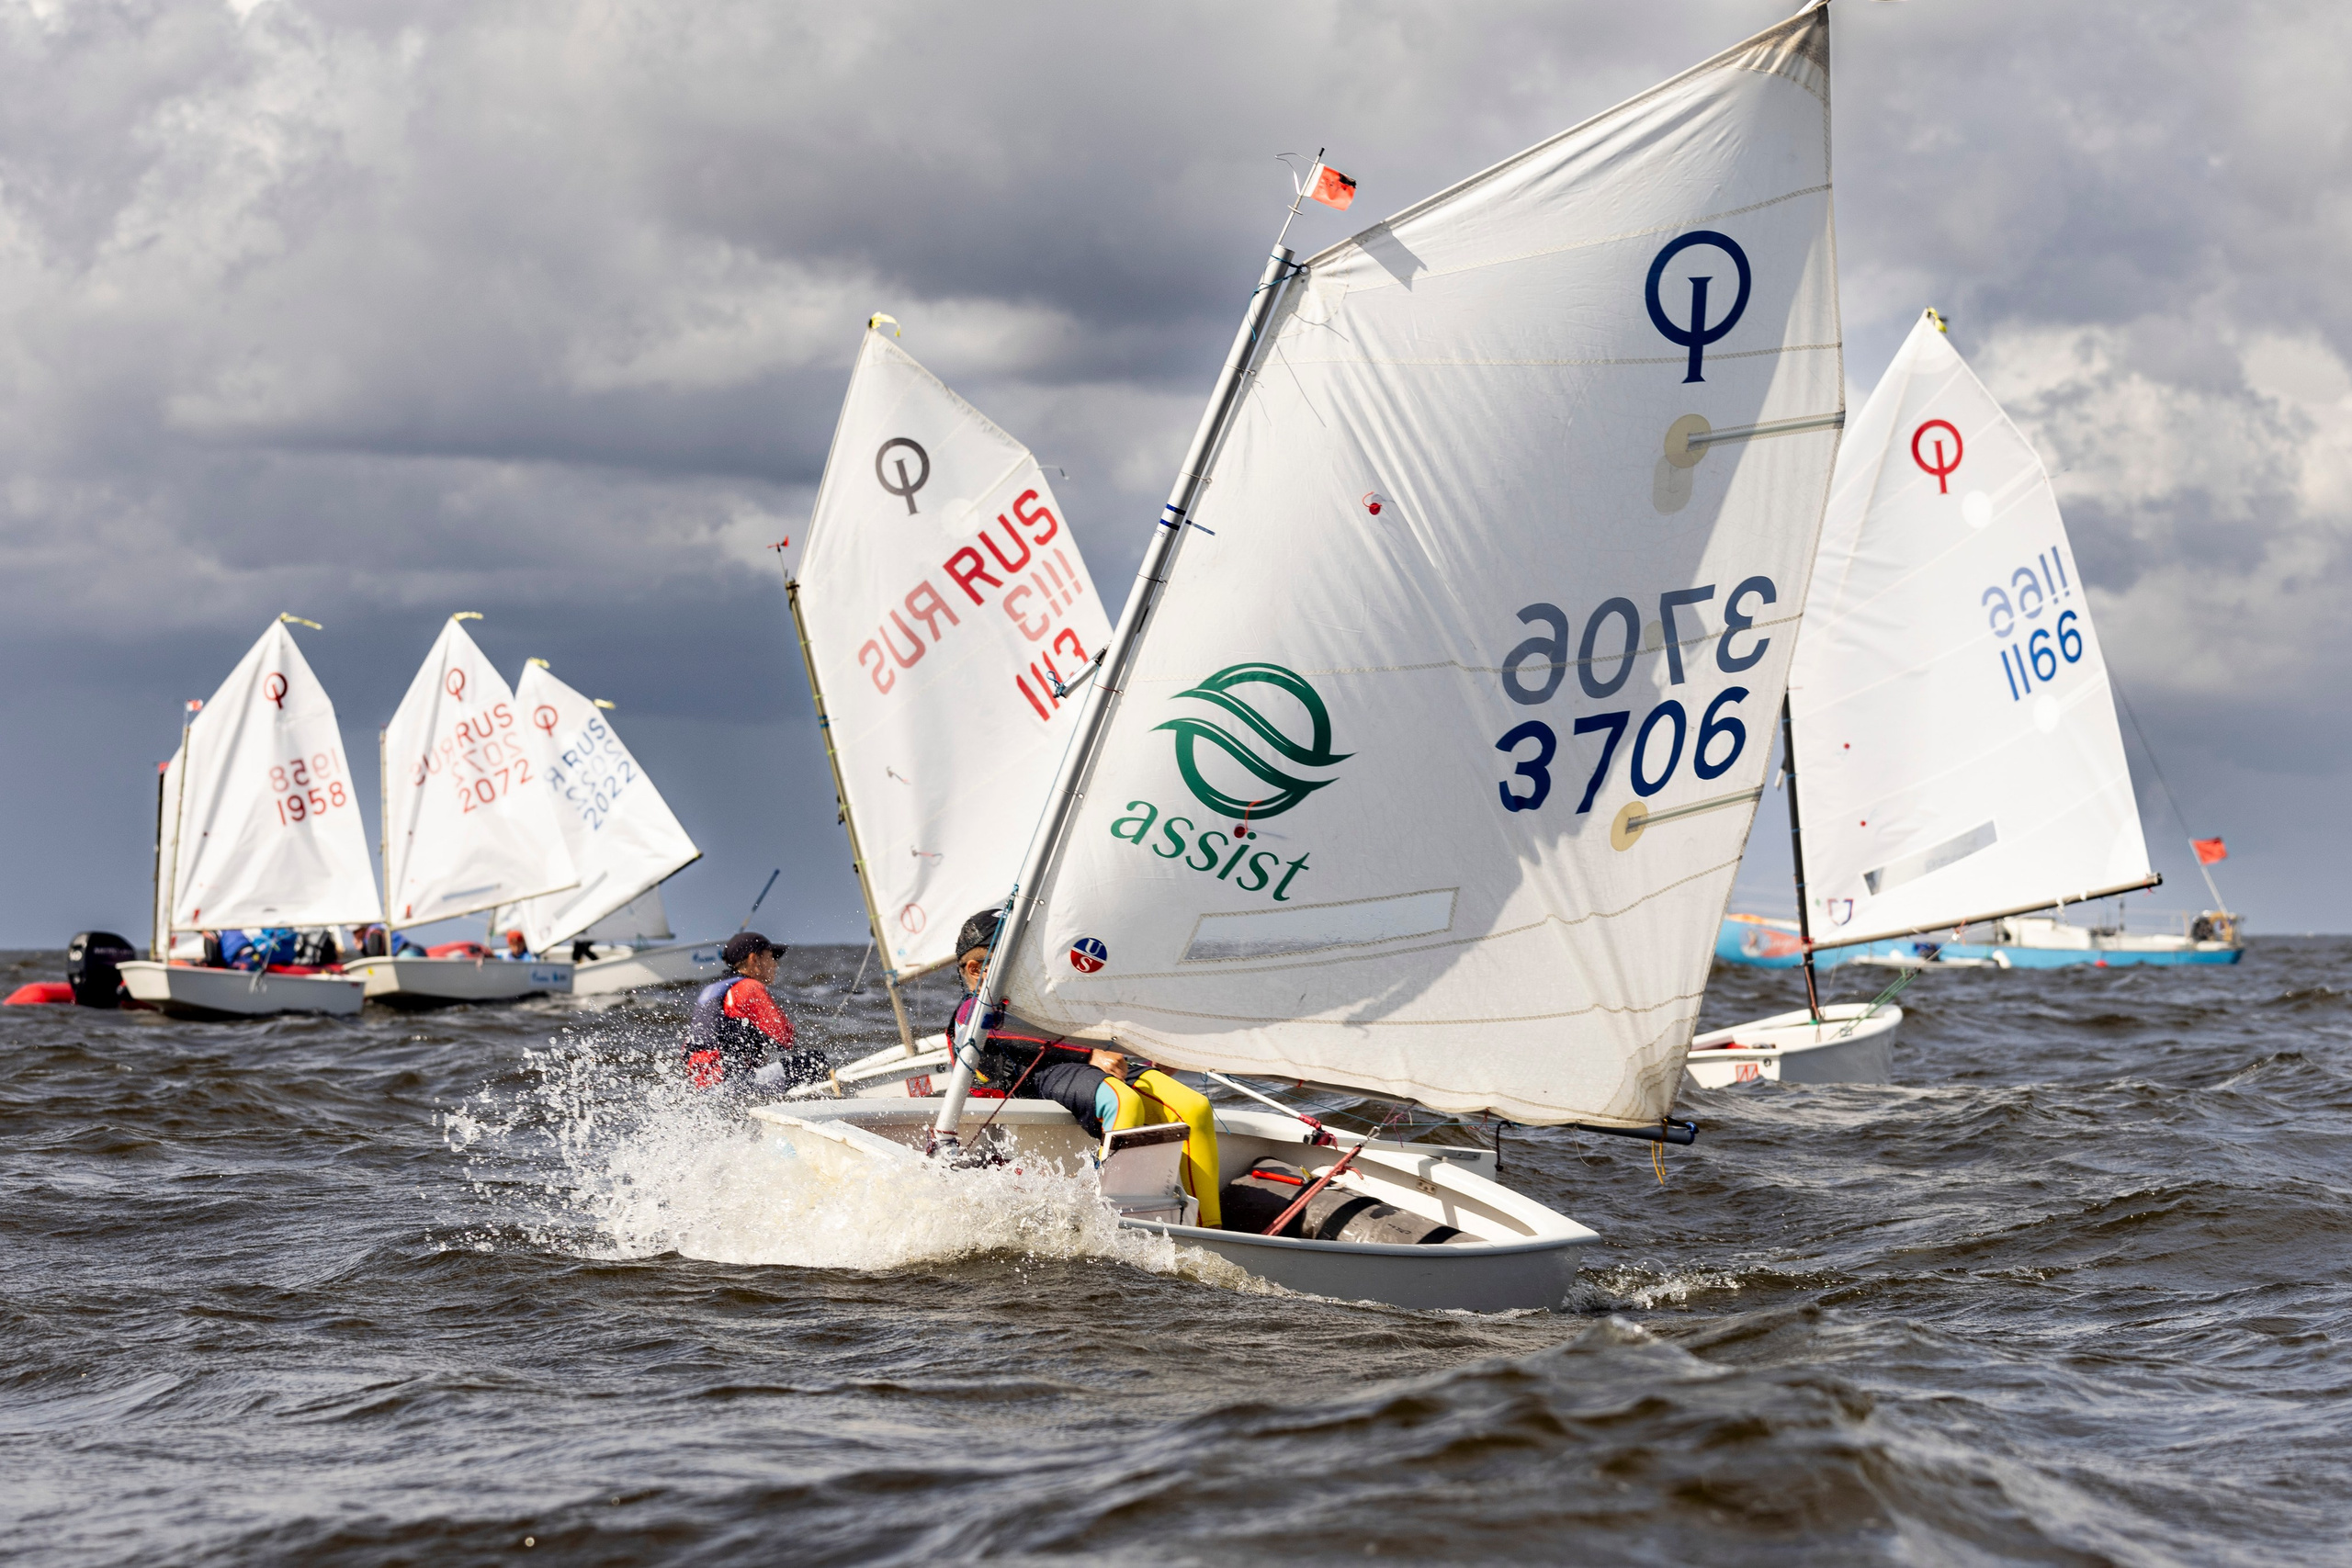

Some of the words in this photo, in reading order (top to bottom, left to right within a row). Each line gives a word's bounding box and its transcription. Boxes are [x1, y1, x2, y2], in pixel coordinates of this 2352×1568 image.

[943, 489, 1058, 606] RUS
[2000, 610, 2083, 702] 1166
[456, 703, 513, 748] RUS
[562, 716, 606, 768] RUS
[1495, 686, 1751, 815] 3706
[277, 781, 346, 827] 1958
[458, 758, 534, 814] 2072
[583, 761, 637, 830] 2022
[1110, 800, 1310, 902] assist
